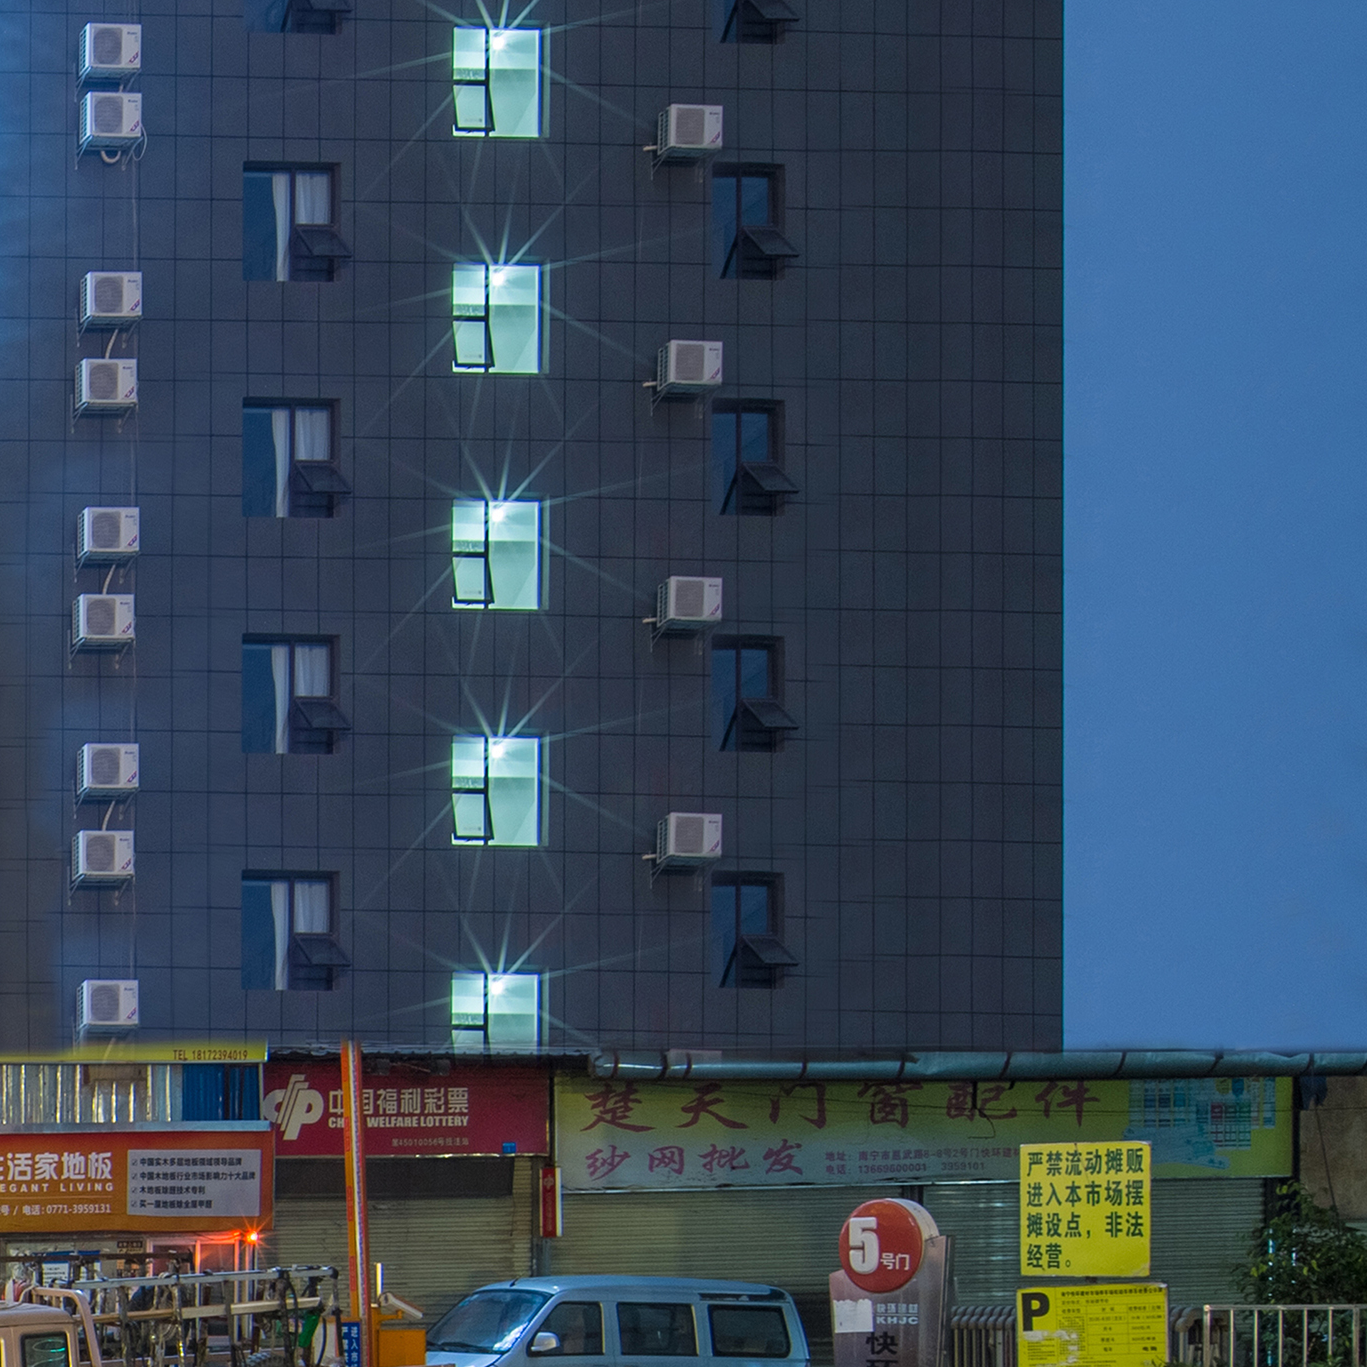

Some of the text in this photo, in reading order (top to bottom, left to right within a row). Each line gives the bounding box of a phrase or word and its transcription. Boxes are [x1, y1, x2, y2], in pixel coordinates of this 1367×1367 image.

[173, 1049, 248, 1061] TEL 18172394019
[367, 1116, 469, 1128] WELFARE LOTTERY
[586, 1138, 805, 1180] 纱网批发
[1026, 1148, 1145, 1178] 严禁流动摊贩
[60, 1183, 115, 1193] LIVING
[1026, 1179, 1145, 1208] 进入本市场摆
[849, 1217, 910, 1275] 5 号门
[876, 1316, 919, 1325] KHJC
[1021, 1292, 1050, 1332] P
